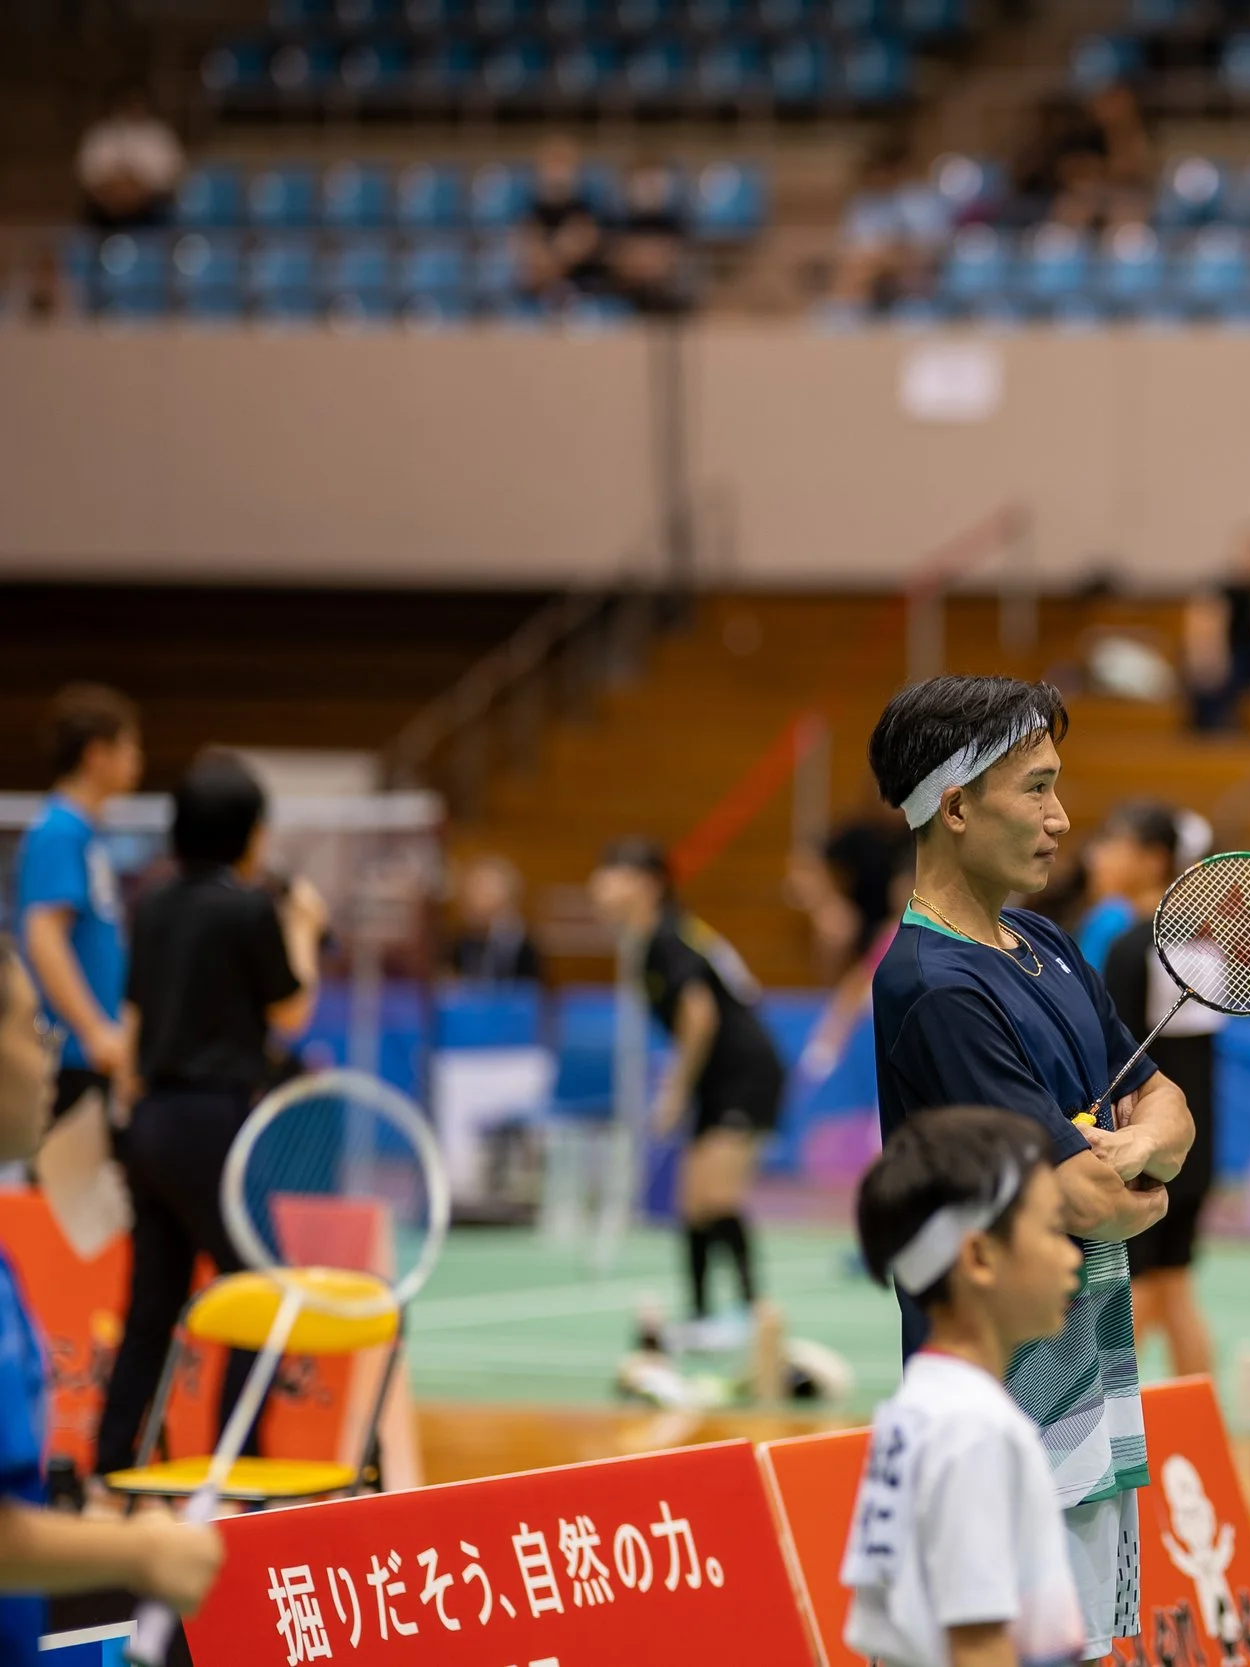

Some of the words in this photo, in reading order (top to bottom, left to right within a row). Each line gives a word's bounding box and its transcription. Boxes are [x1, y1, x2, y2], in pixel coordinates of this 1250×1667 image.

[267, 1501, 725, 1666] 掘りだそう、自然の力。
